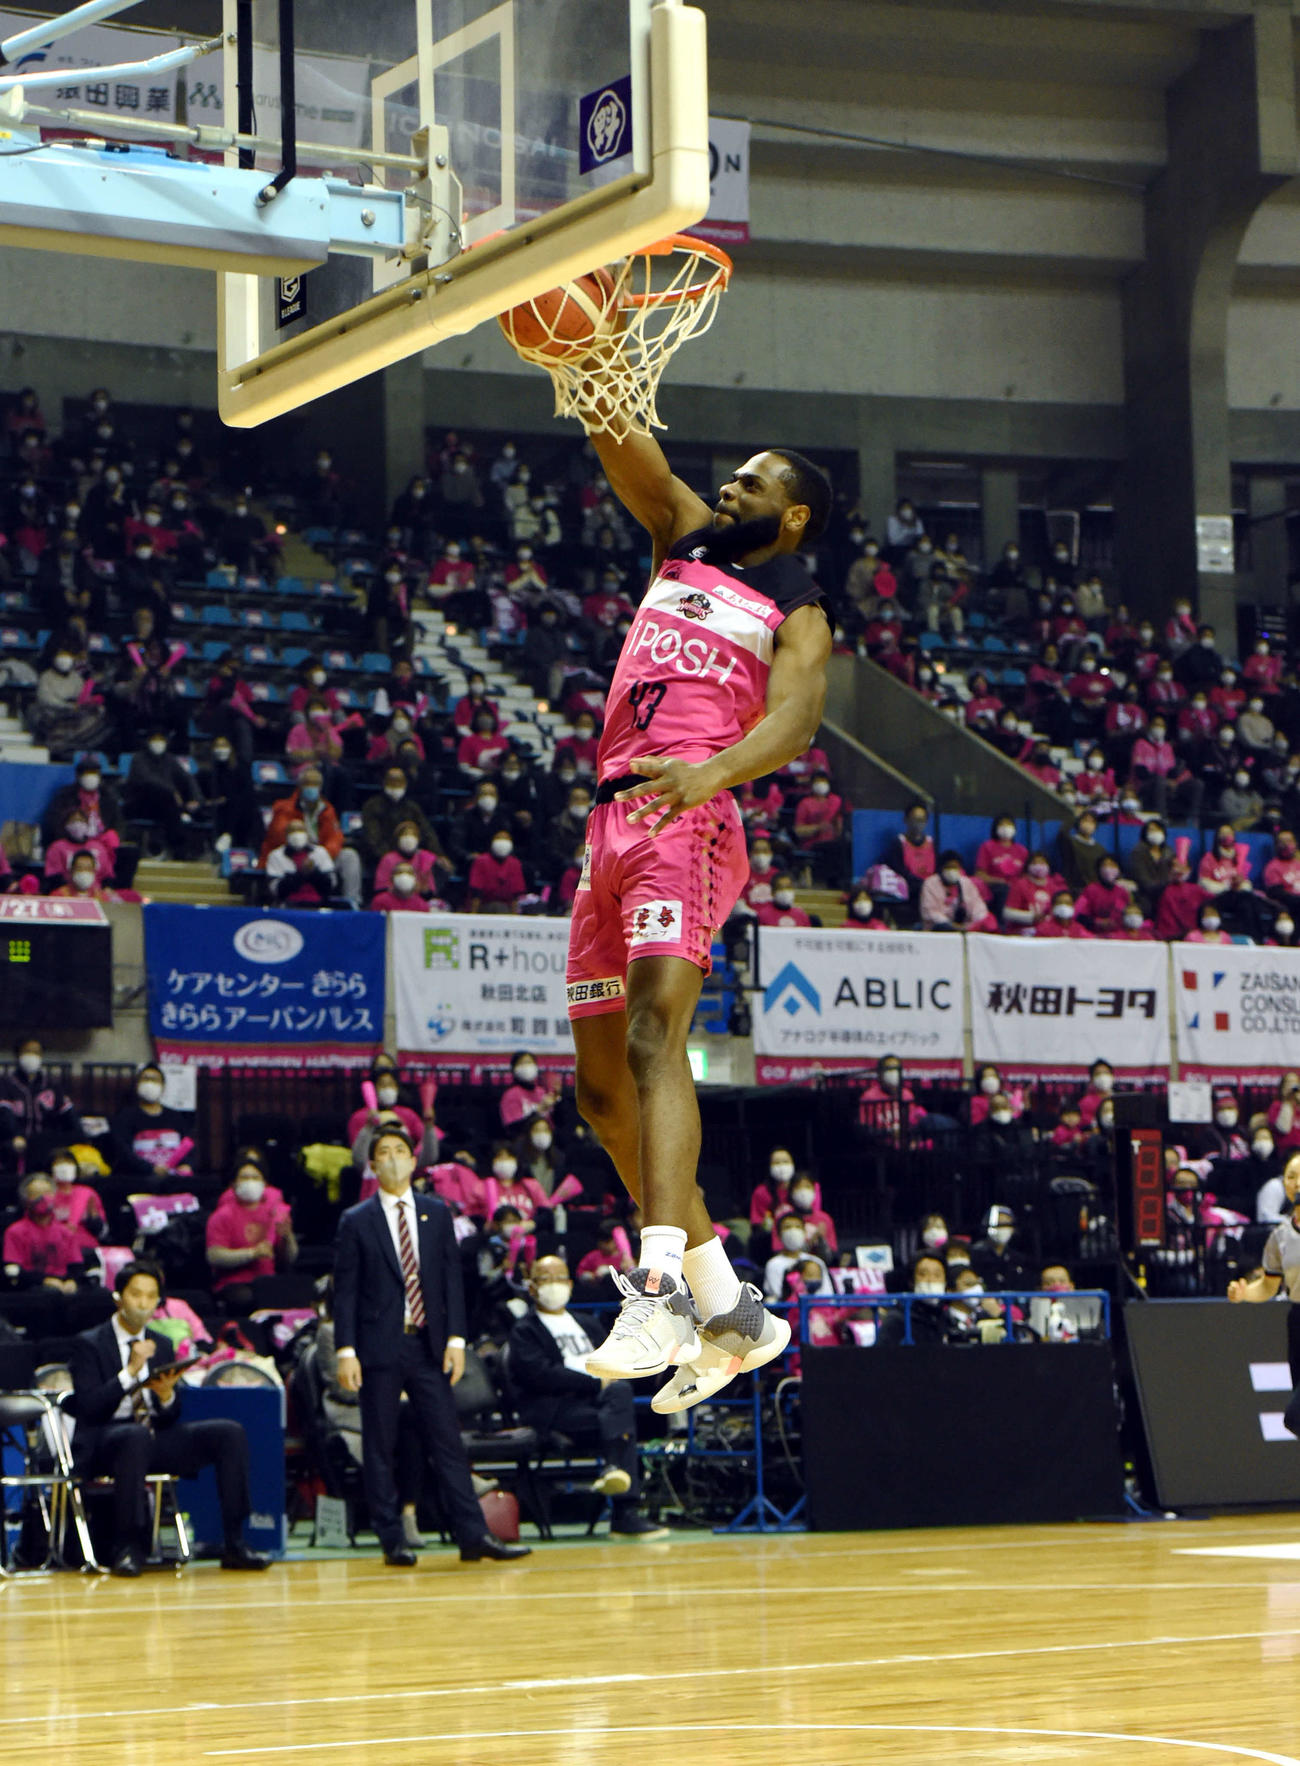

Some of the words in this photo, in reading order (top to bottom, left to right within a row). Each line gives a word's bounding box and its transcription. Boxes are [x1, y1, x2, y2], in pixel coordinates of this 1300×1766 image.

[834, 976, 952, 1010] ABLIC
[986, 981, 1157, 1019] 秋田トヨタ
